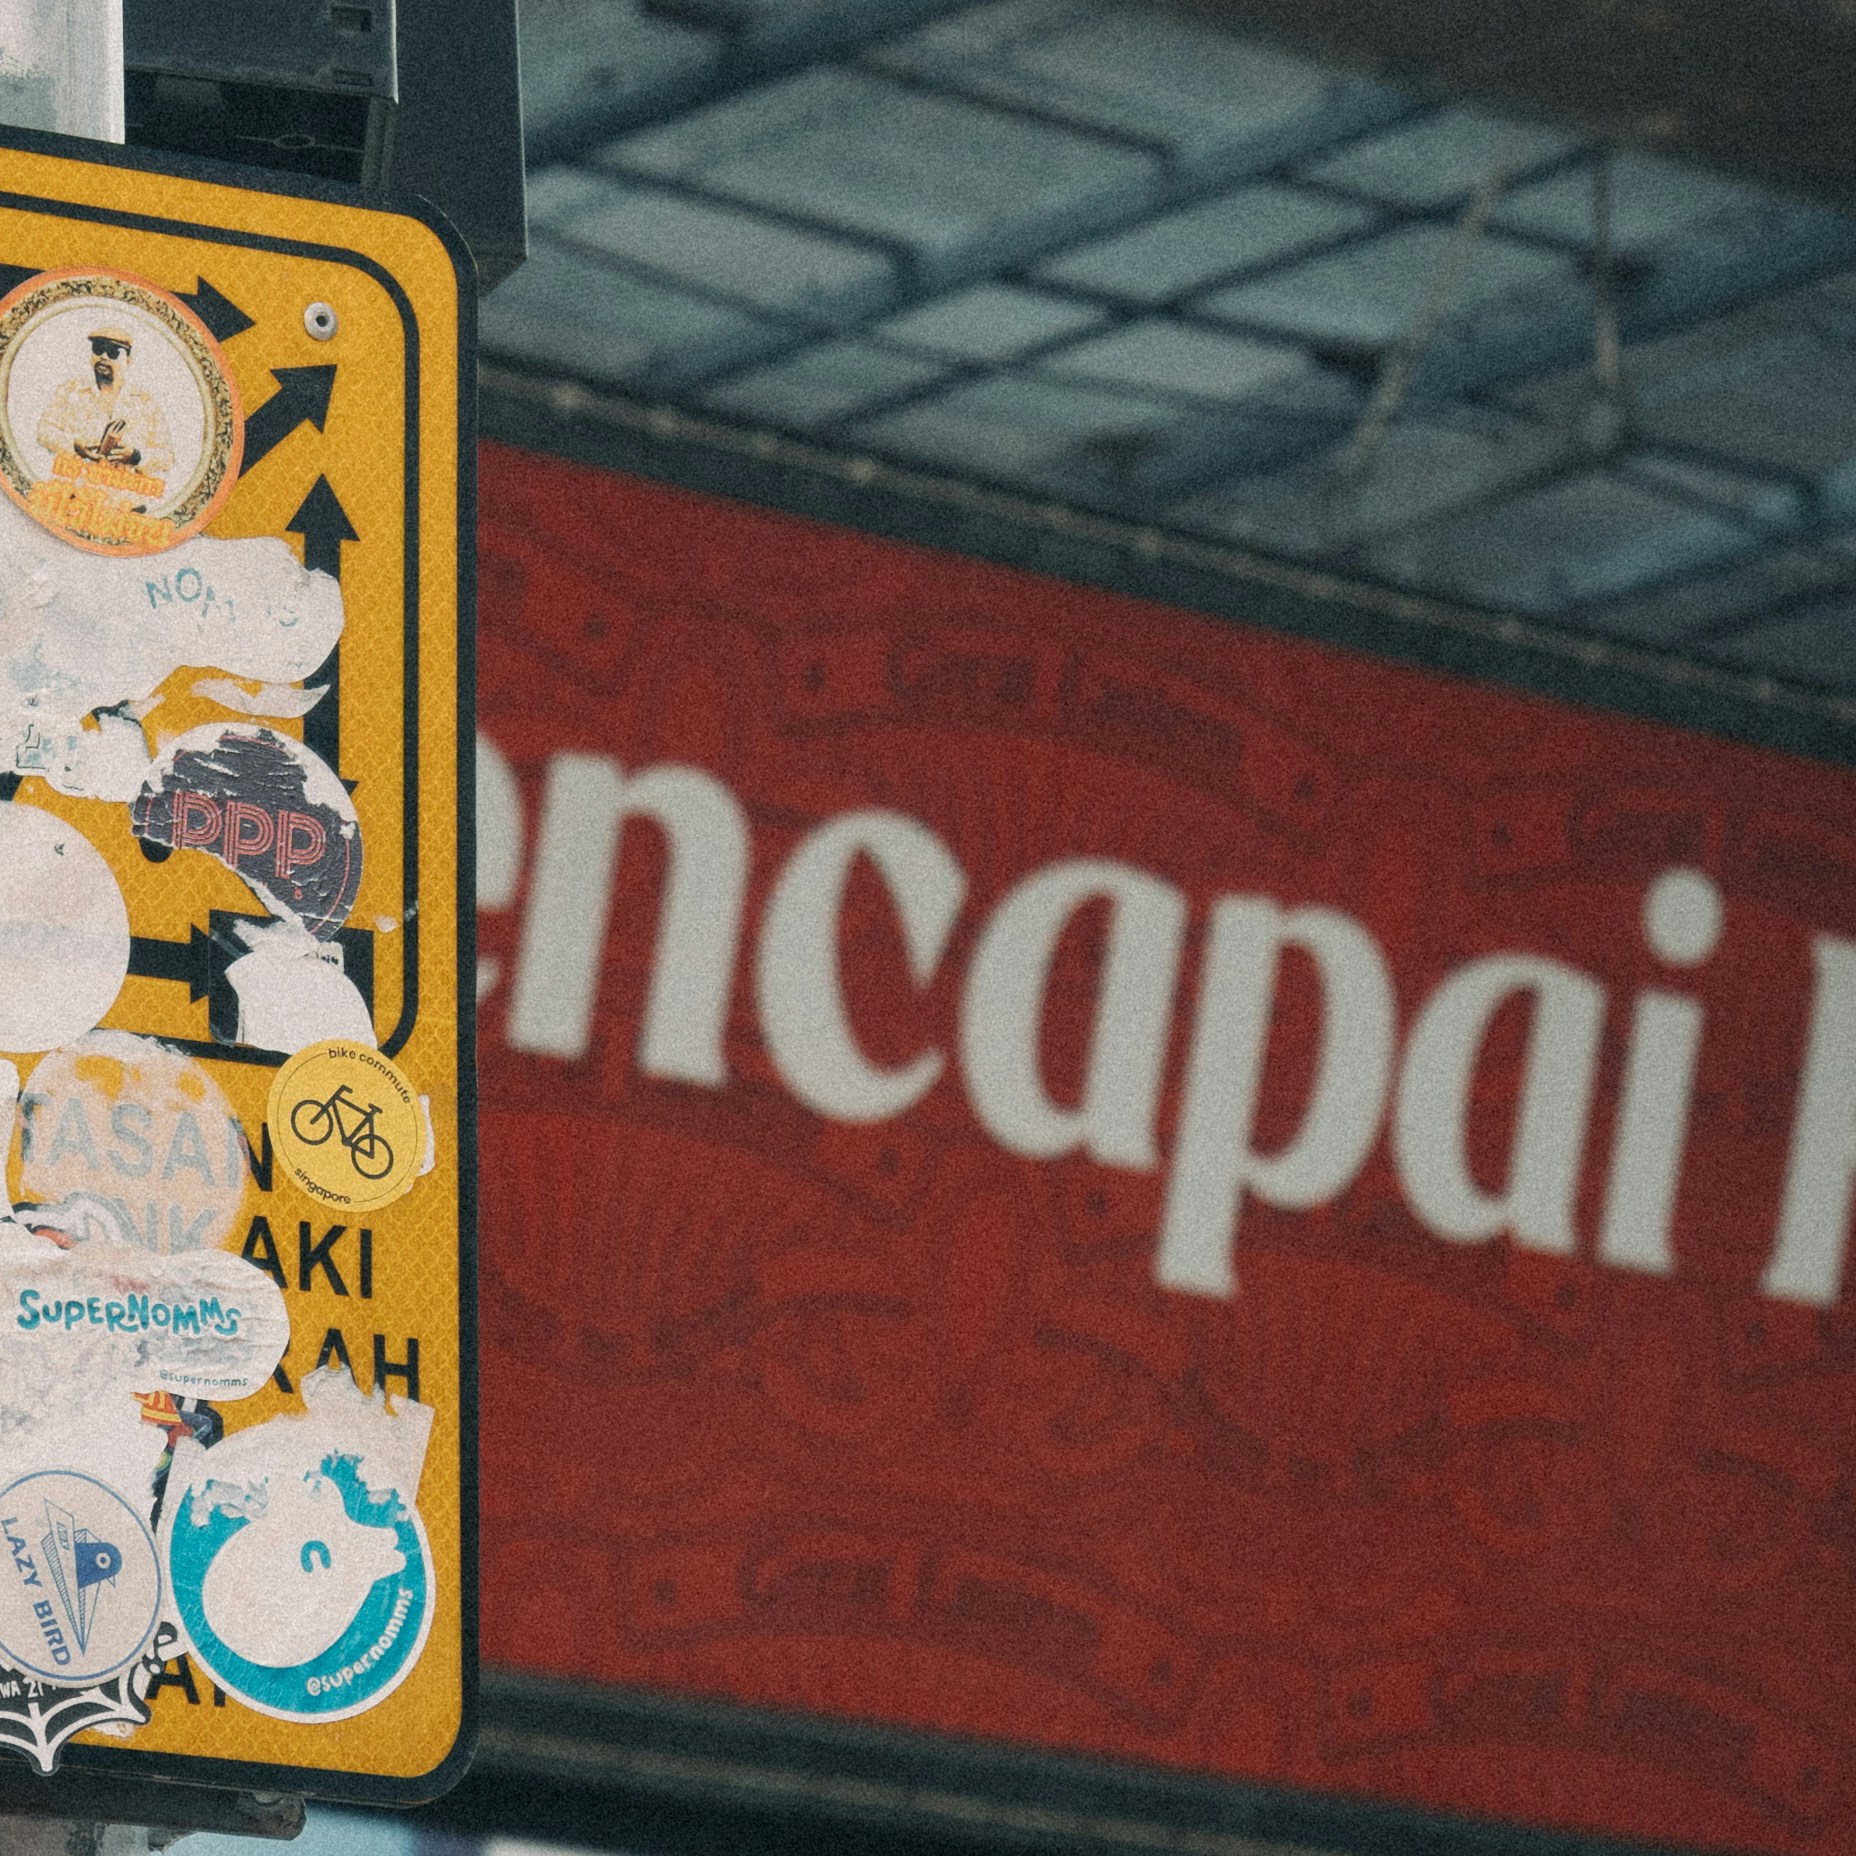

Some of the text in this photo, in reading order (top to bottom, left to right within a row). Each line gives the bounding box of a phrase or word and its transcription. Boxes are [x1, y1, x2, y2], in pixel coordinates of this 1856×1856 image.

[328, 1047, 411, 1104] bike commute
[294, 1167, 352, 1205] singapore
[159, 1369, 249, 1388] @supernomms
[1, 1516, 71, 1666] LAZY BIRD
[305, 1588, 414, 1696] @supernomms
